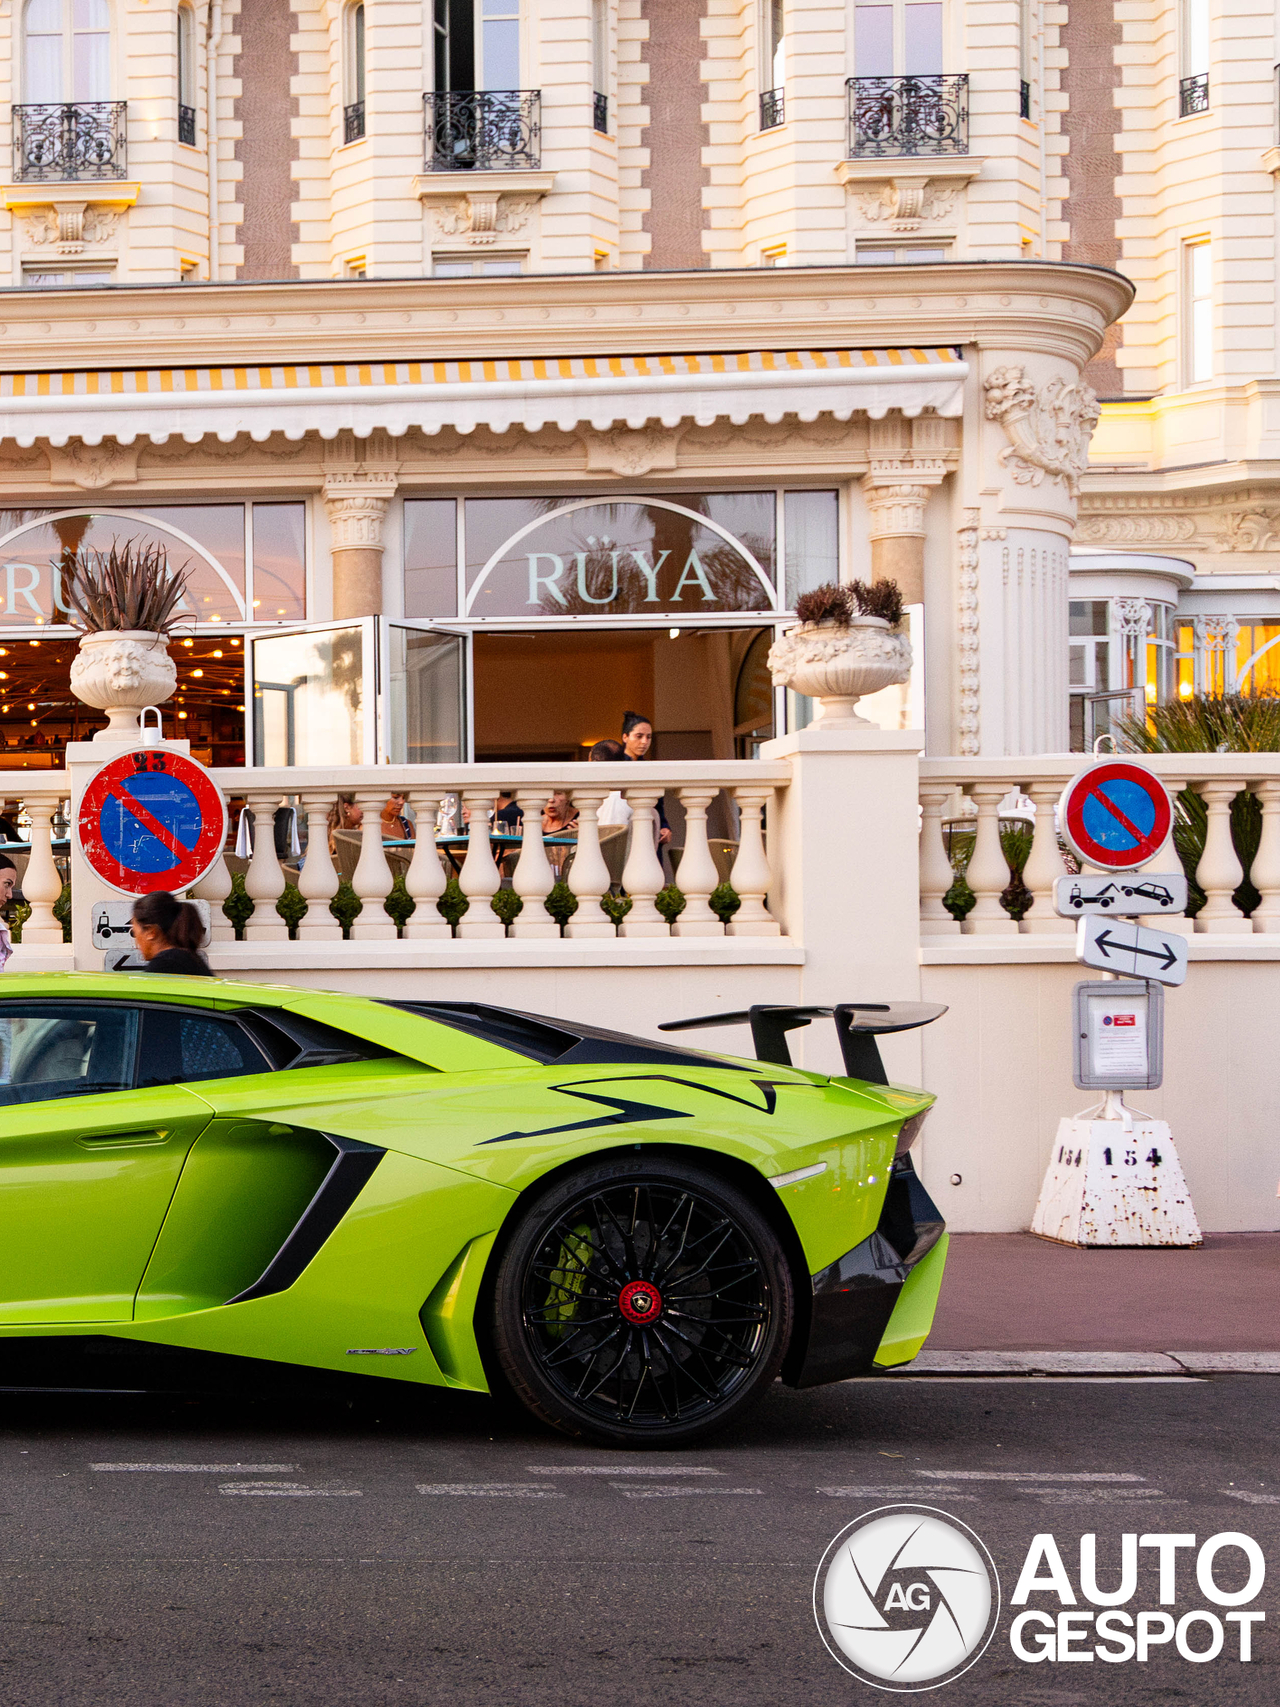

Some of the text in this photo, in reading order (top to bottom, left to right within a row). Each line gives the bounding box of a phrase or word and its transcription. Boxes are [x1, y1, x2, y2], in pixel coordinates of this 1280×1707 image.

[524, 535, 719, 606] RÜYA
[134, 752, 167, 772] 23
[1103, 1147, 1163, 1167] 154
